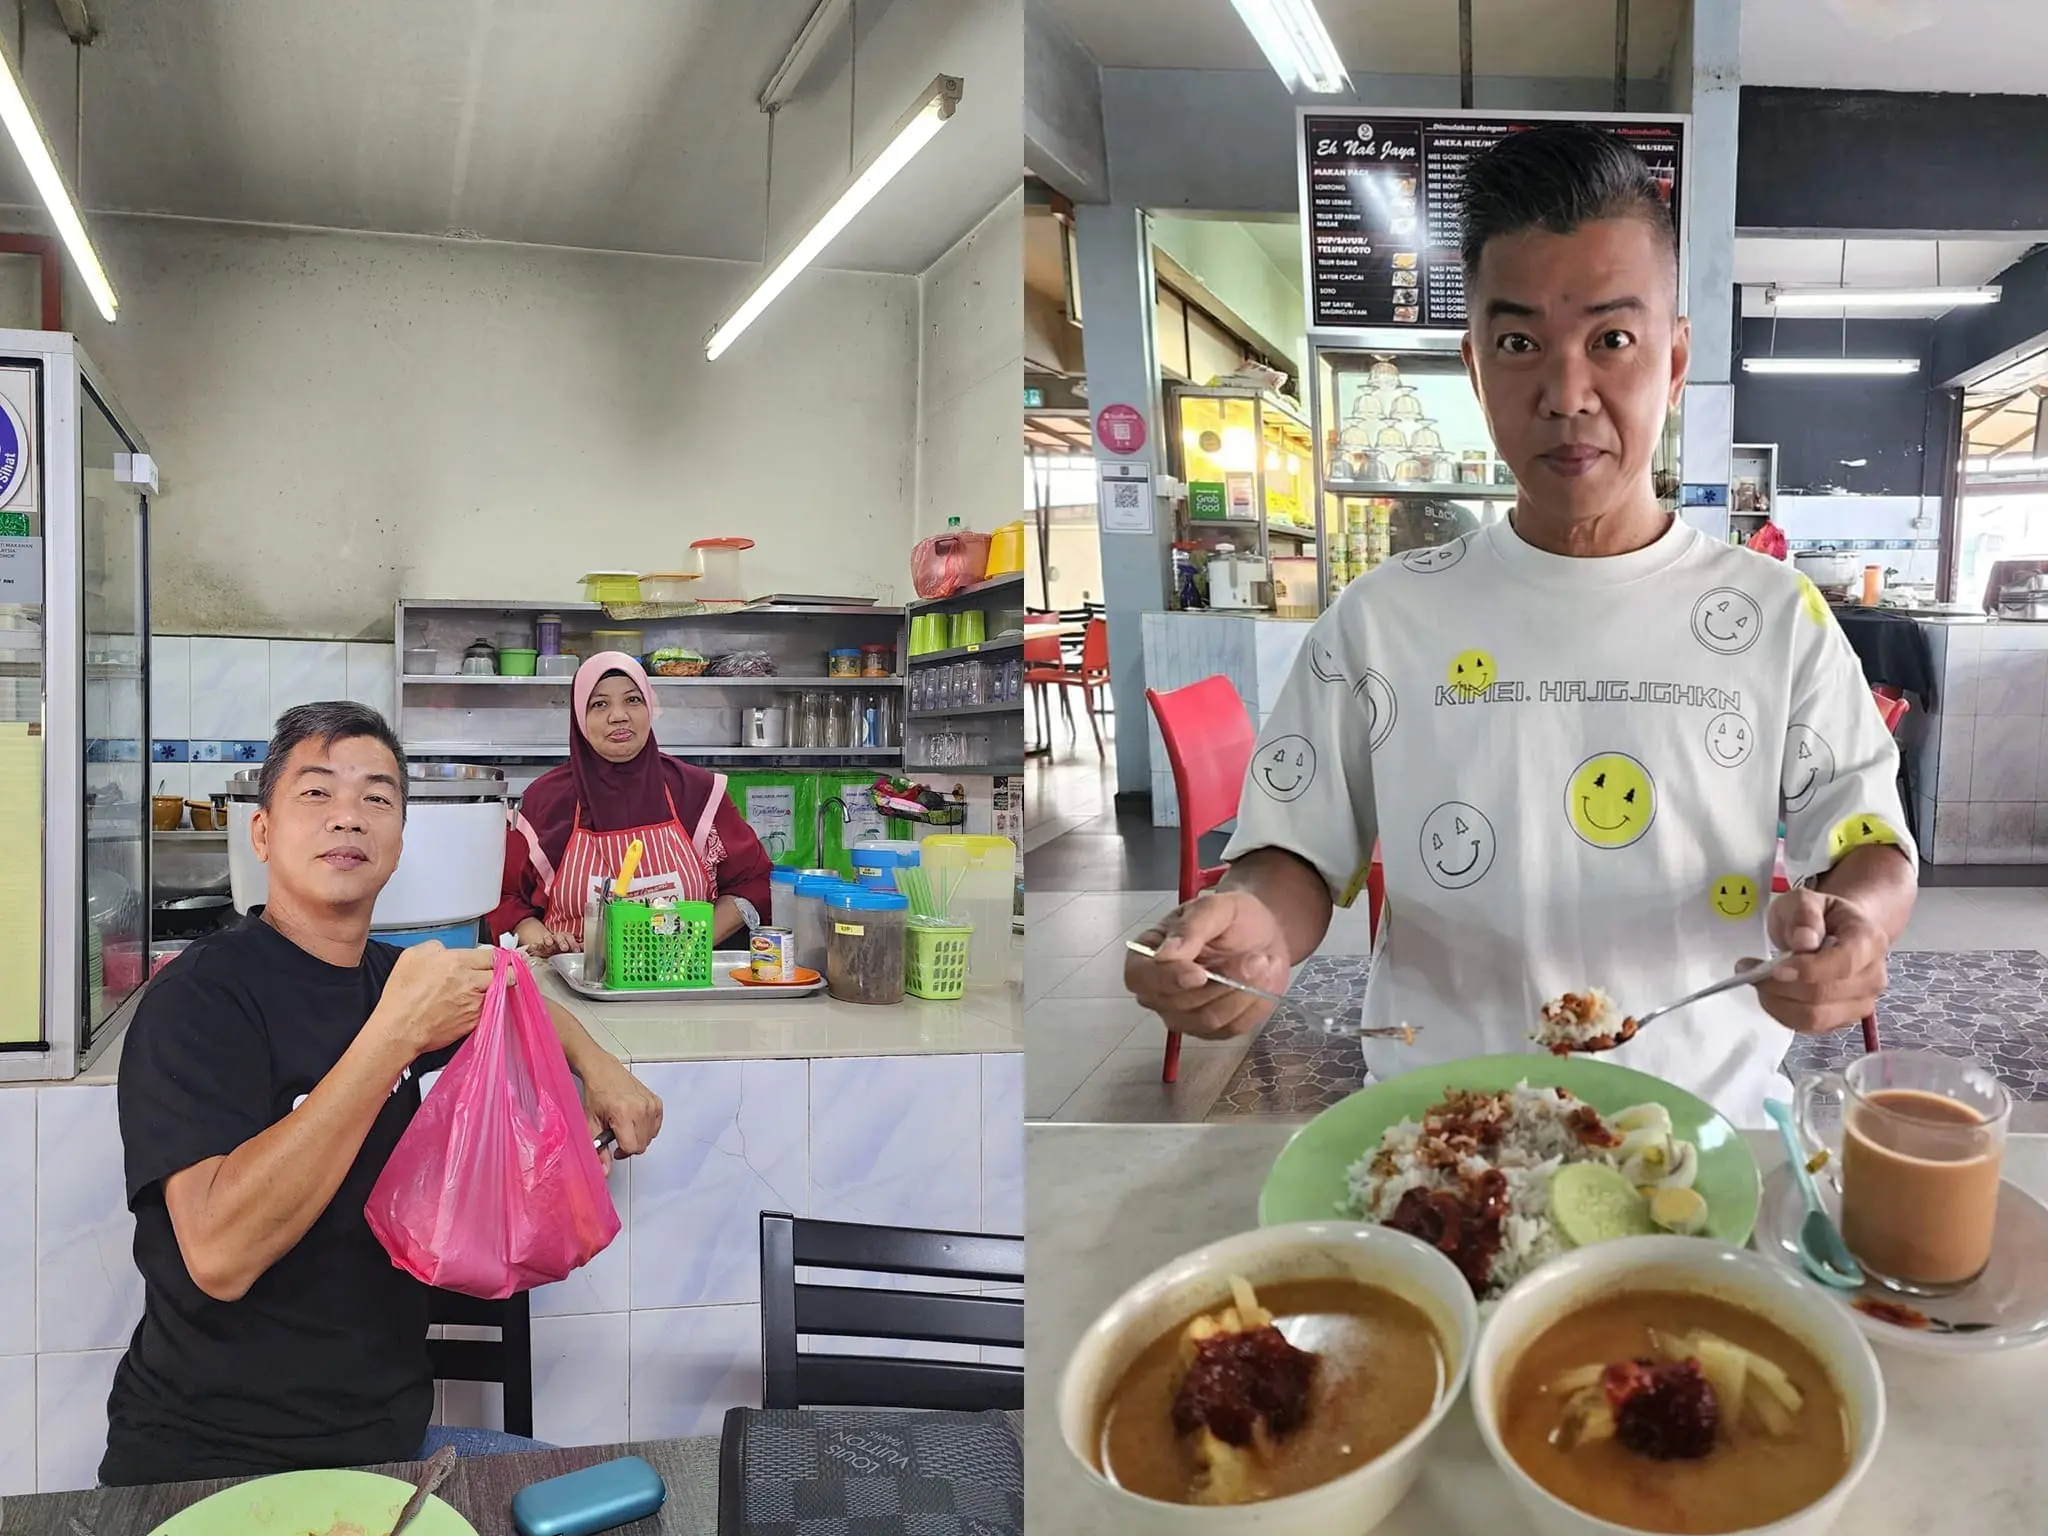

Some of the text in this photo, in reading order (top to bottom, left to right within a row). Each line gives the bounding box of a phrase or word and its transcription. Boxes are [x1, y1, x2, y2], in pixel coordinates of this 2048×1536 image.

[1477, 124, 1507, 133] dengan
[1433, 139, 1462, 147] ANEKA
[1343, 140, 1376, 156] Nak
[1380, 140, 1416, 160] Jaya
[1314, 168, 1346, 176] MAKAN
[1317, 246, 1372, 254] TELUR/SOTO
[1196, 494, 1219, 504] Grab
[1196, 503, 1220, 512] Food
[1424, 505, 1458, 521] BLACK
[866, 1429, 905, 1447] PARIS
[831, 1431, 911, 1469] VUITTON
[824, 1445, 880, 1474] LOUIS
